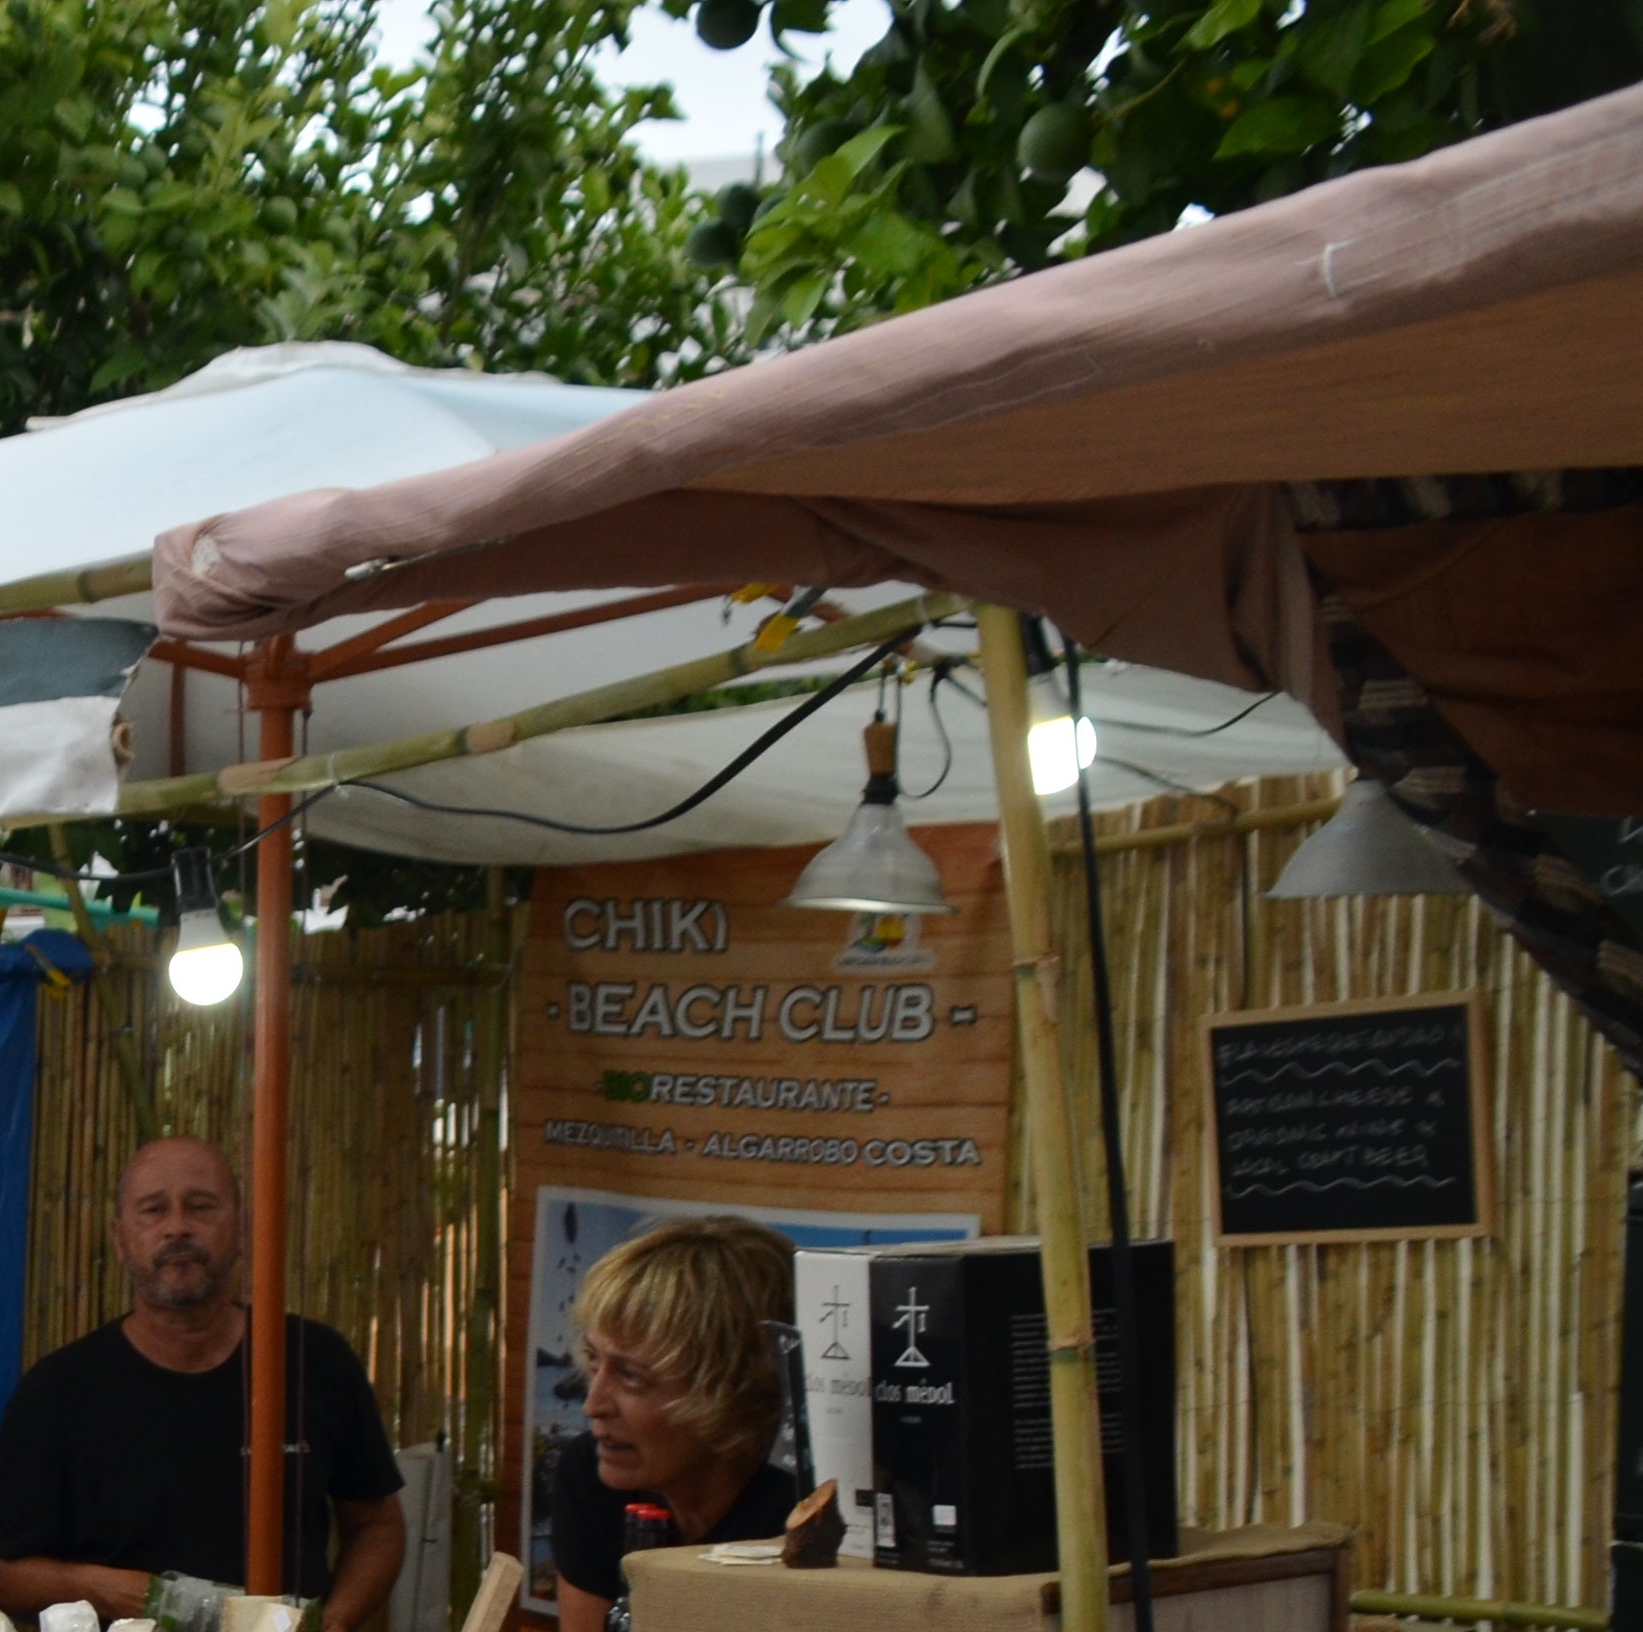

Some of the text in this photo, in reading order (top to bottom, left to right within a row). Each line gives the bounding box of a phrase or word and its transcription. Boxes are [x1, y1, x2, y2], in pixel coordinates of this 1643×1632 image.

[568, 981, 769, 1040] BEACH
[778, 982, 936, 1044] CLUB
[702, 1131, 858, 1164] ALGARROBO
[862, 1138, 981, 1167] COSTA
